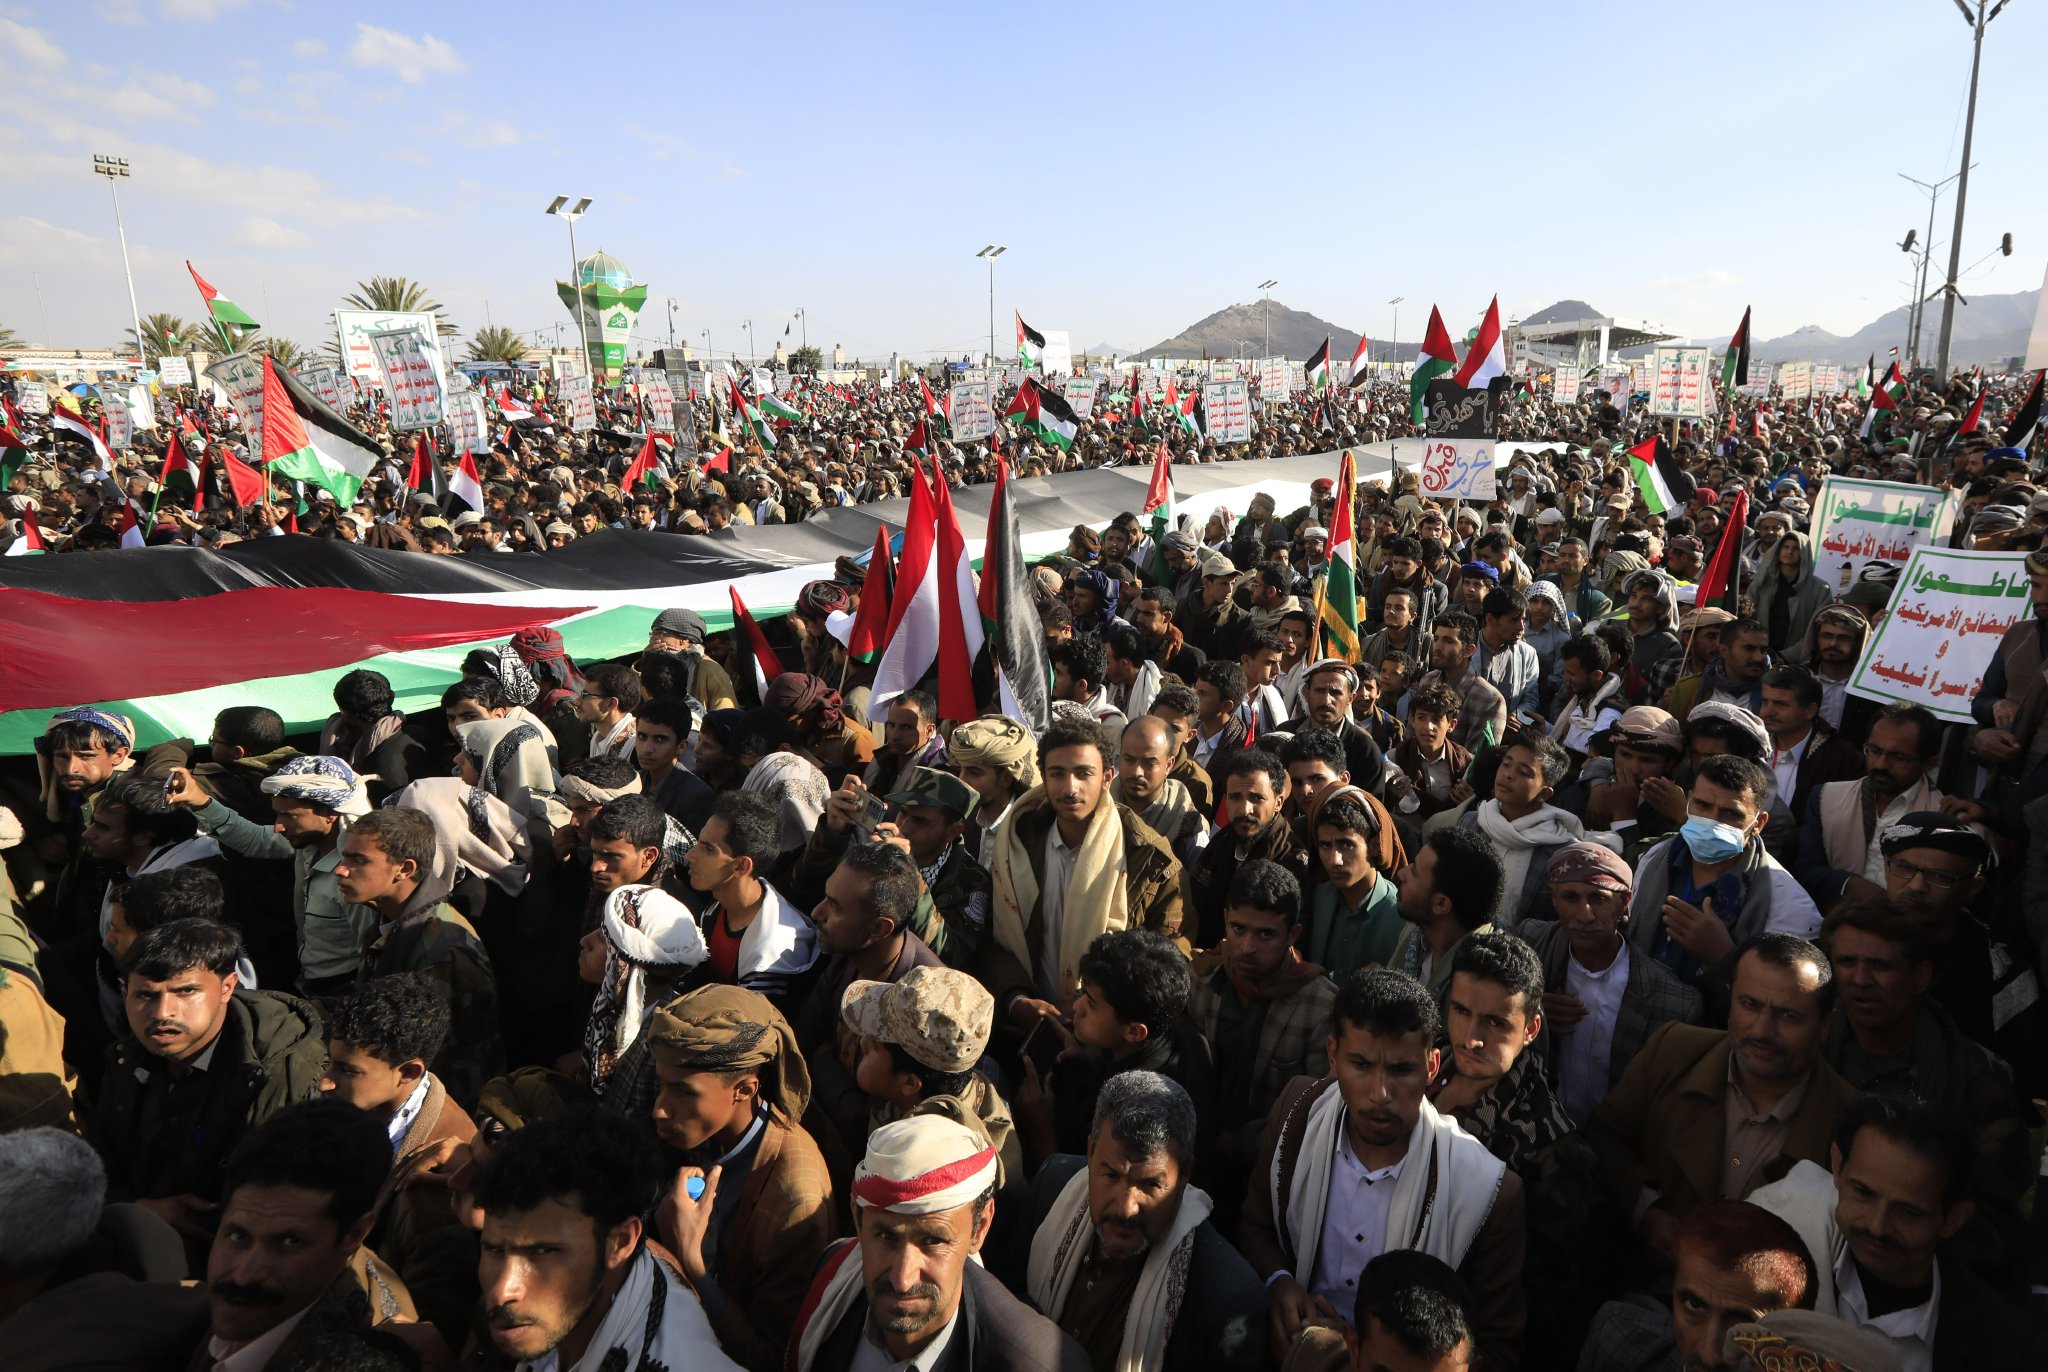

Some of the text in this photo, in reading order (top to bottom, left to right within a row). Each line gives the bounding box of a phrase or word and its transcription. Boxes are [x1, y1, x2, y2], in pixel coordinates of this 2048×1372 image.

[1829, 492, 1936, 528] قاطعوا
[1822, 531, 1909, 561] ضائع الأمريكية
[1896, 599, 1963, 629] الأمريكية
[1935, 639, 1949, 659] و
